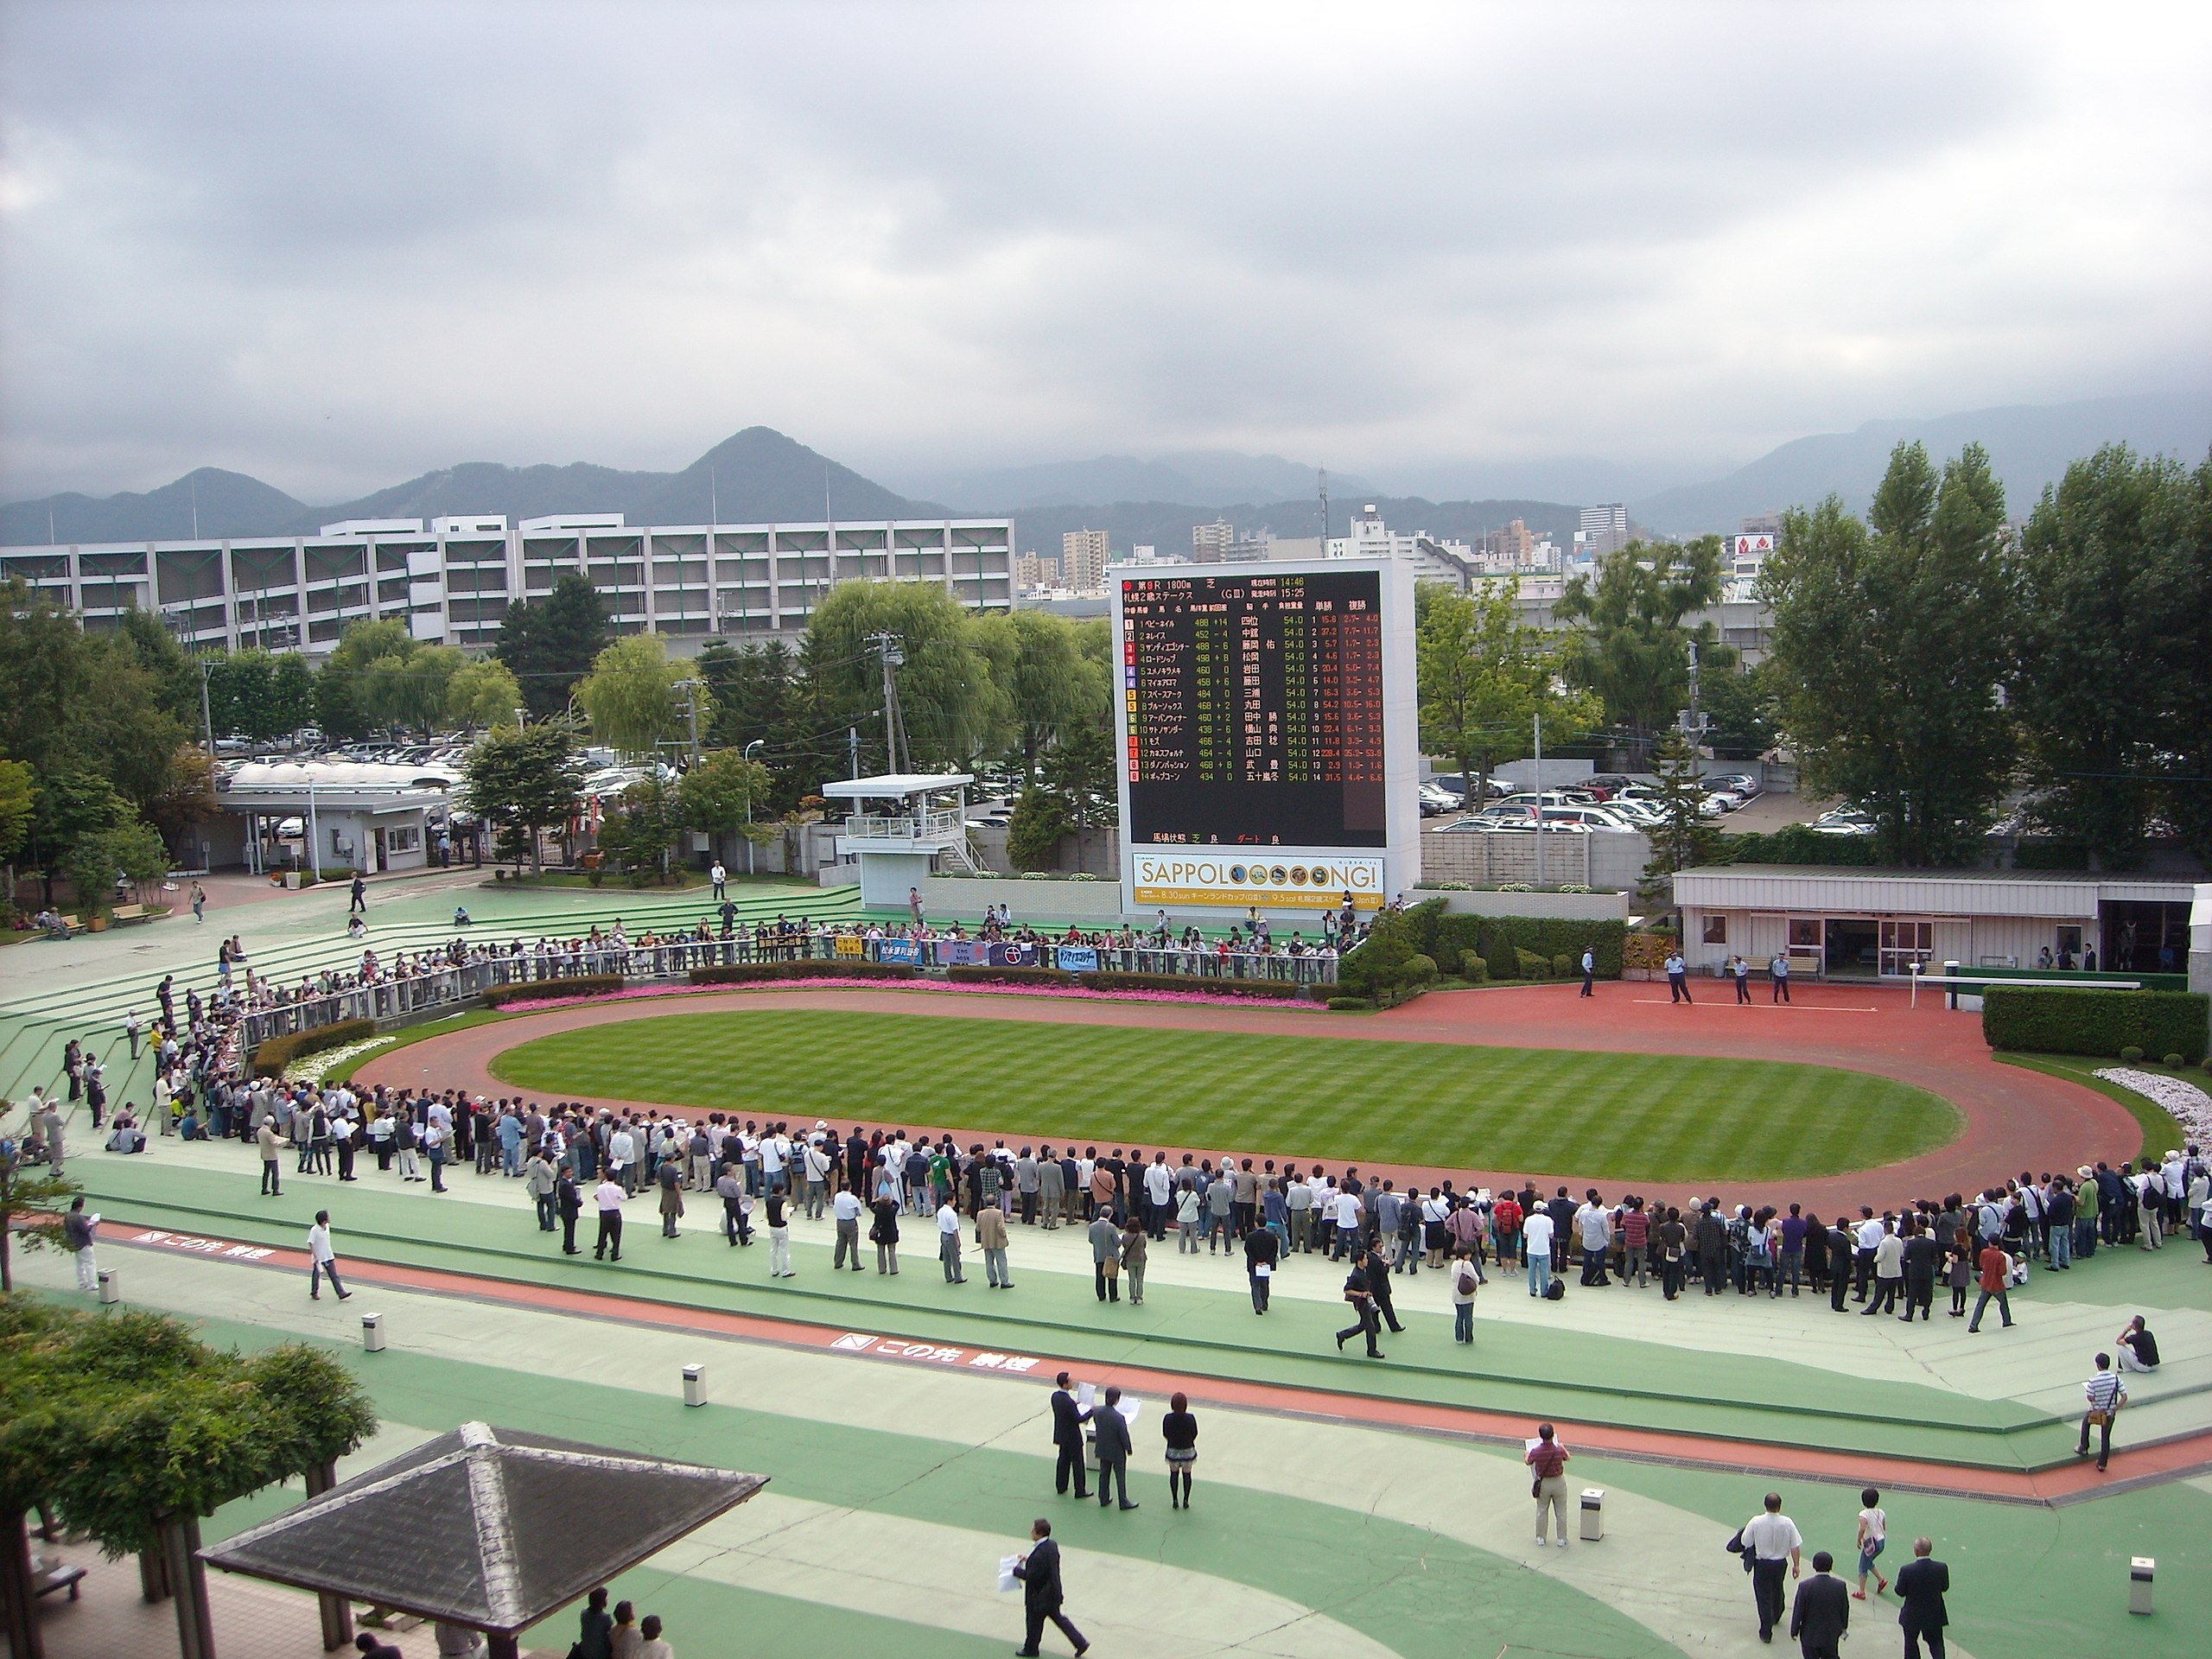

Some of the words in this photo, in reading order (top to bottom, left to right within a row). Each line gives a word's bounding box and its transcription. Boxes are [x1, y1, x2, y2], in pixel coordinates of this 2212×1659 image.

[1167, 580, 1191, 589] 1800m
[1206, 578, 1215, 588] 芝
[1281, 577, 1304, 586] 14:46
[1124, 591, 1193, 602] 札幌2歳ステークス
[1281, 588, 1305, 597] 15:25
[1315, 601, 1333, 611] 単勝
[1195, 618, 1209, 626] 488
[1241, 616, 1258, 626] 四位
[1284, 616, 1304, 624] 54.0
[1284, 628, 1304, 636] 54.0
[1242, 640, 1259, 650] 藤岡
[1285, 640, 1304, 648] 54.0
[1243, 652, 1259, 661] 松岡
[1285, 652, 1304, 660] 54.0
[1196, 666, 1210, 674] 460
[1243, 664, 1260, 673] 岩田
[1286, 664, 1305, 672] 54.0
[1197, 678, 1211, 686] 458
[1286, 676, 1305, 685] 54.0
[1286, 688, 1305, 697] 54.0
[1244, 700, 1260, 709] 丸田
[1286, 700, 1306, 709] 54.0
[1198, 714, 1212, 722] 460
[1245, 712, 1261, 721] 田中
[1287, 713, 1306, 721] 54.0
[1269, 724, 1278, 734] 典
[1245, 736, 1262, 745] 吉田
[1246, 747, 1262, 757] 山口
[1150, 760, 1190, 769] ダノンパッション
[1246, 760, 1255, 769] 武
[1289, 773, 1308, 781] 54.0
[1153, 833, 1186, 843] 馬場状態
[1192, 833, 1201, 843] 芝
[1210, 833, 1219, 844] 良
[1237, 834, 1260, 844] ダート
[1271, 835, 1280, 845] 良
[163, 1236, 226, 1252] この先
[877, 1340, 964, 1362] この先
